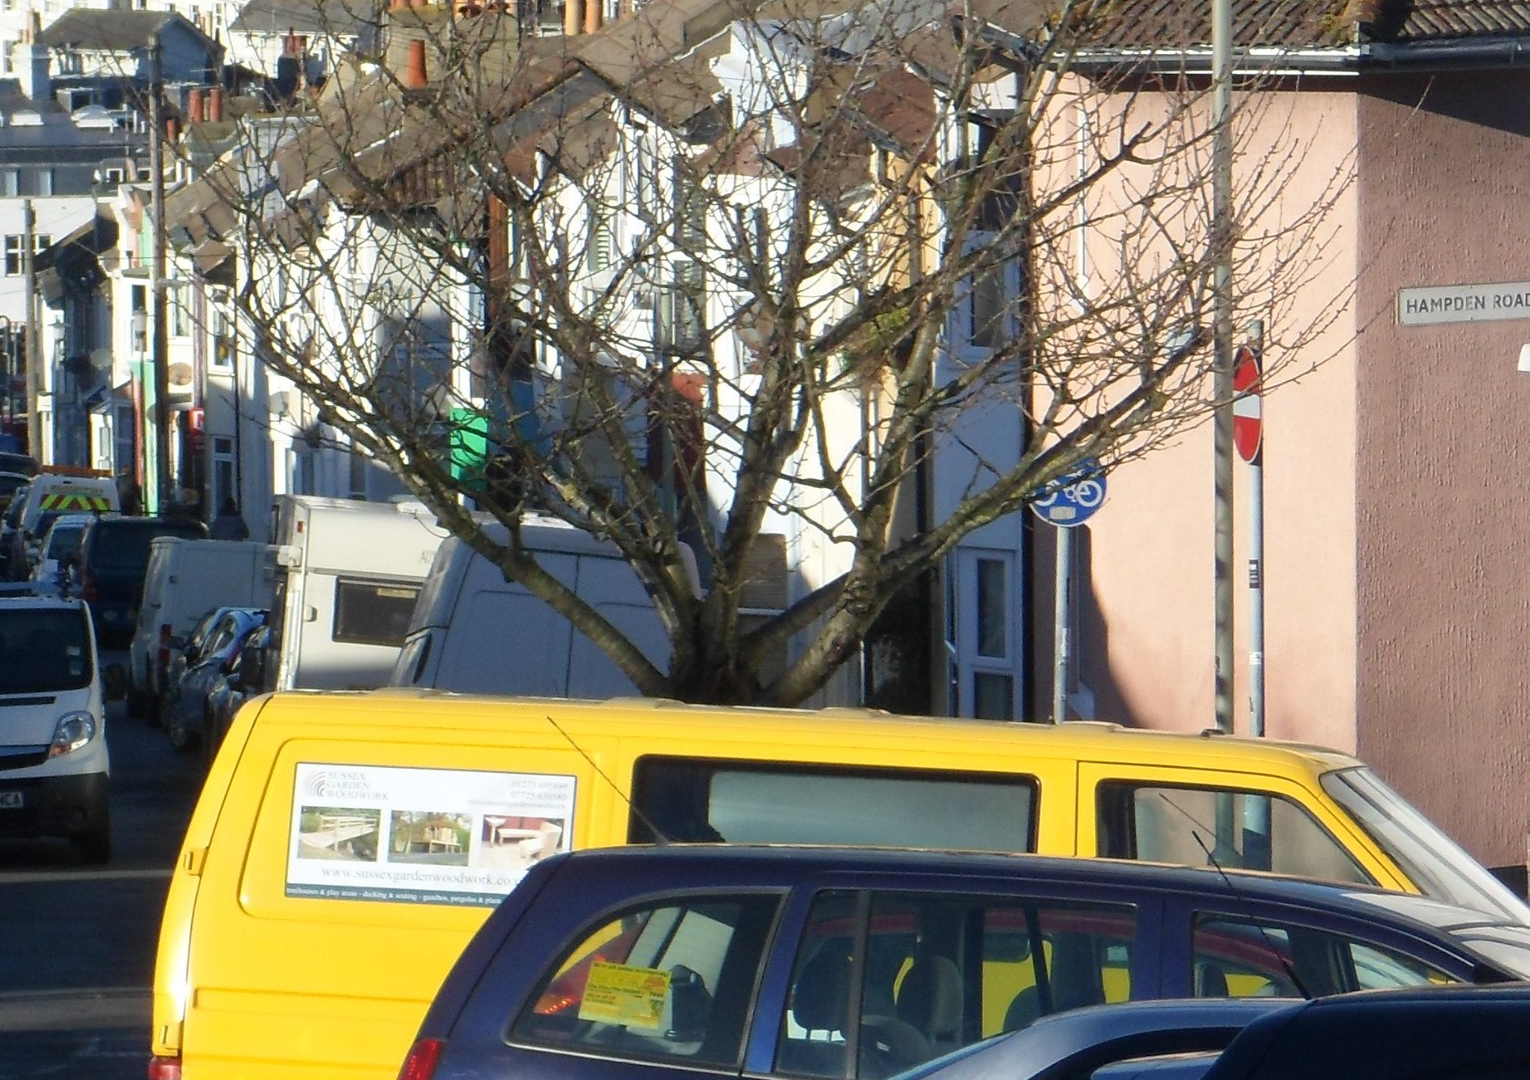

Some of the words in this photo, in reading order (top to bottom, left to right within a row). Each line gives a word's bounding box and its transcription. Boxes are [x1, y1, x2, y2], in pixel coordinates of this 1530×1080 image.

[1406, 295, 1485, 314] HAMPDEN
[328, 771, 367, 781] SUSSEX
[327, 781, 370, 790] GARDEN
[327, 790, 390, 801] WOODWORK
